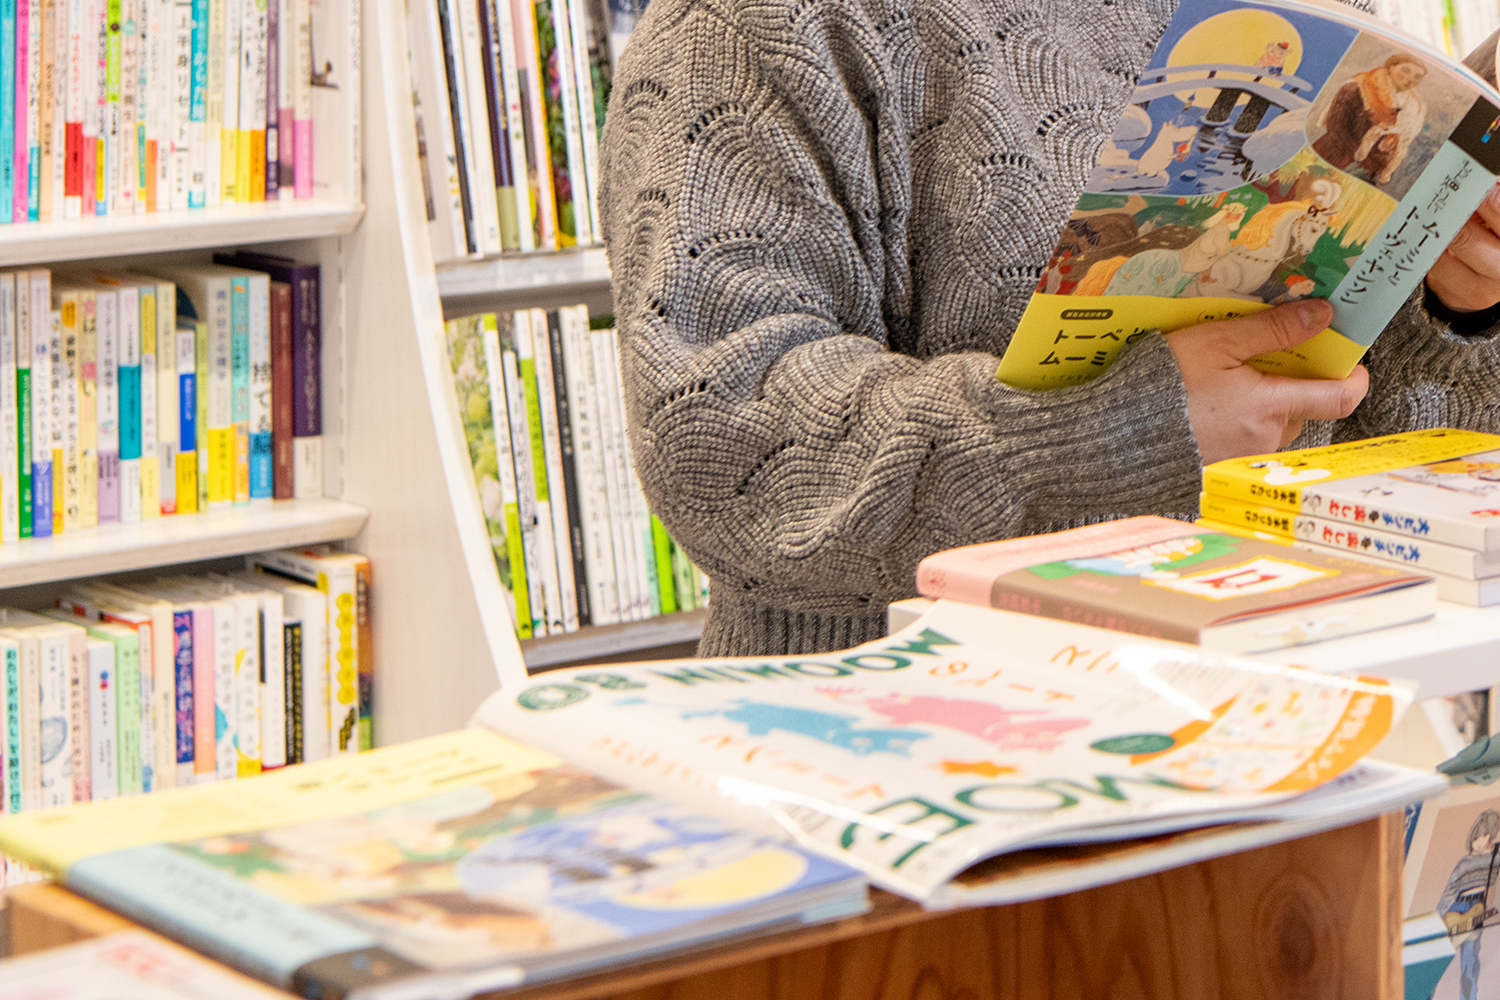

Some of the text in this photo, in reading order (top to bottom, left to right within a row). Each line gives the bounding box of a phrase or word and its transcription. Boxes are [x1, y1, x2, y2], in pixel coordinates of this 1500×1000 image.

[1387, 221, 1440, 287] ムーミンと
[1053, 327, 1146, 345] トーベと
[1038, 350, 1109, 366] ムーミ
